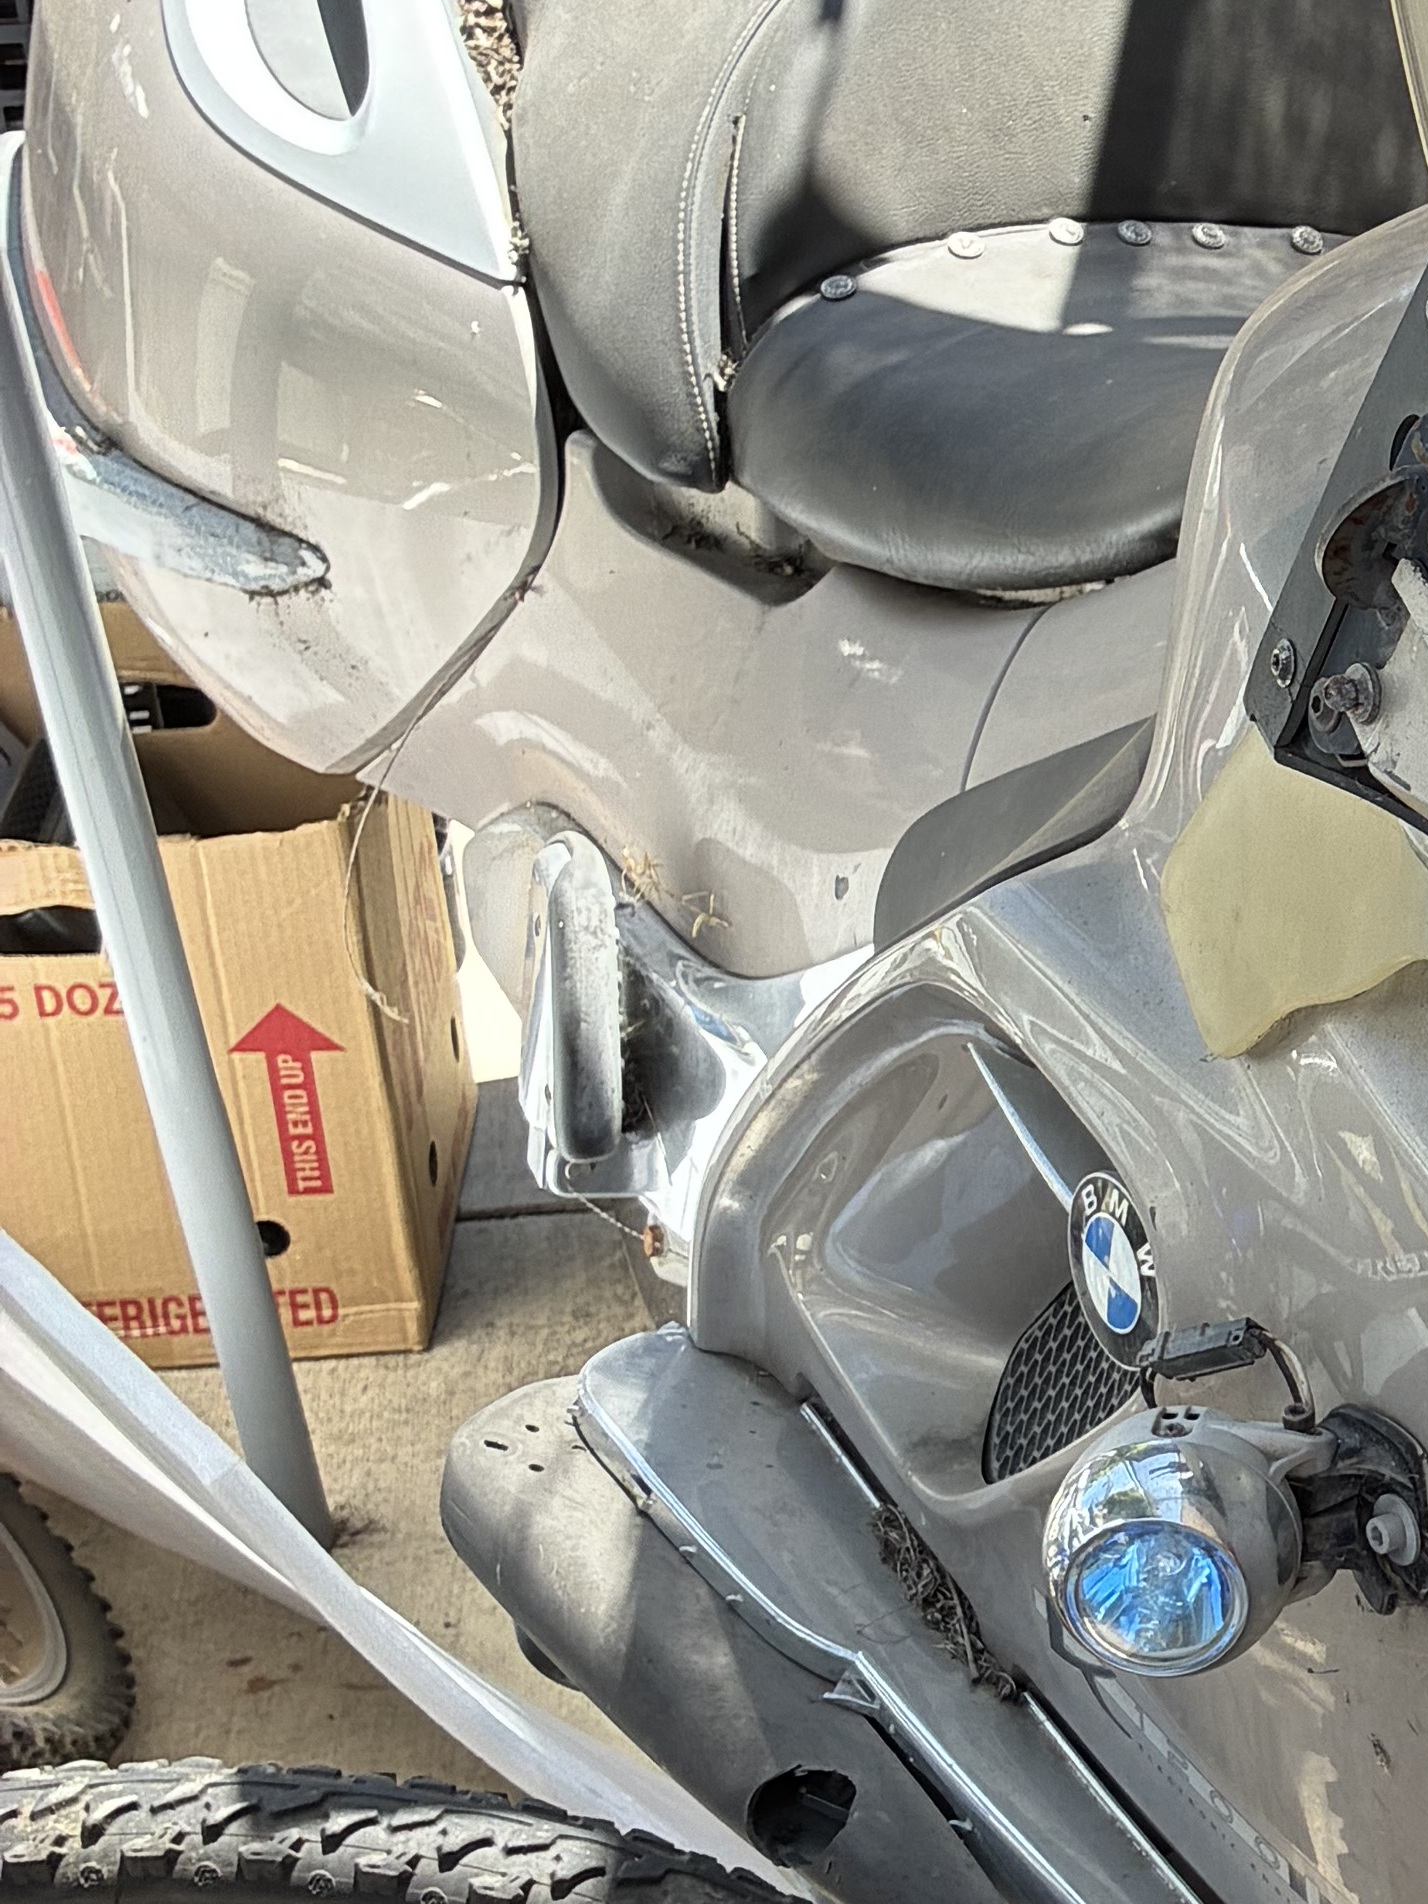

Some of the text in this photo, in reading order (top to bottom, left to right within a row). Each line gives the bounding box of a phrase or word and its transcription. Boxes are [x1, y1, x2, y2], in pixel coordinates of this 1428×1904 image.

[276, 1053, 323, 1192] THIS END UP
[1081, 1183, 1157, 1277] BMW
